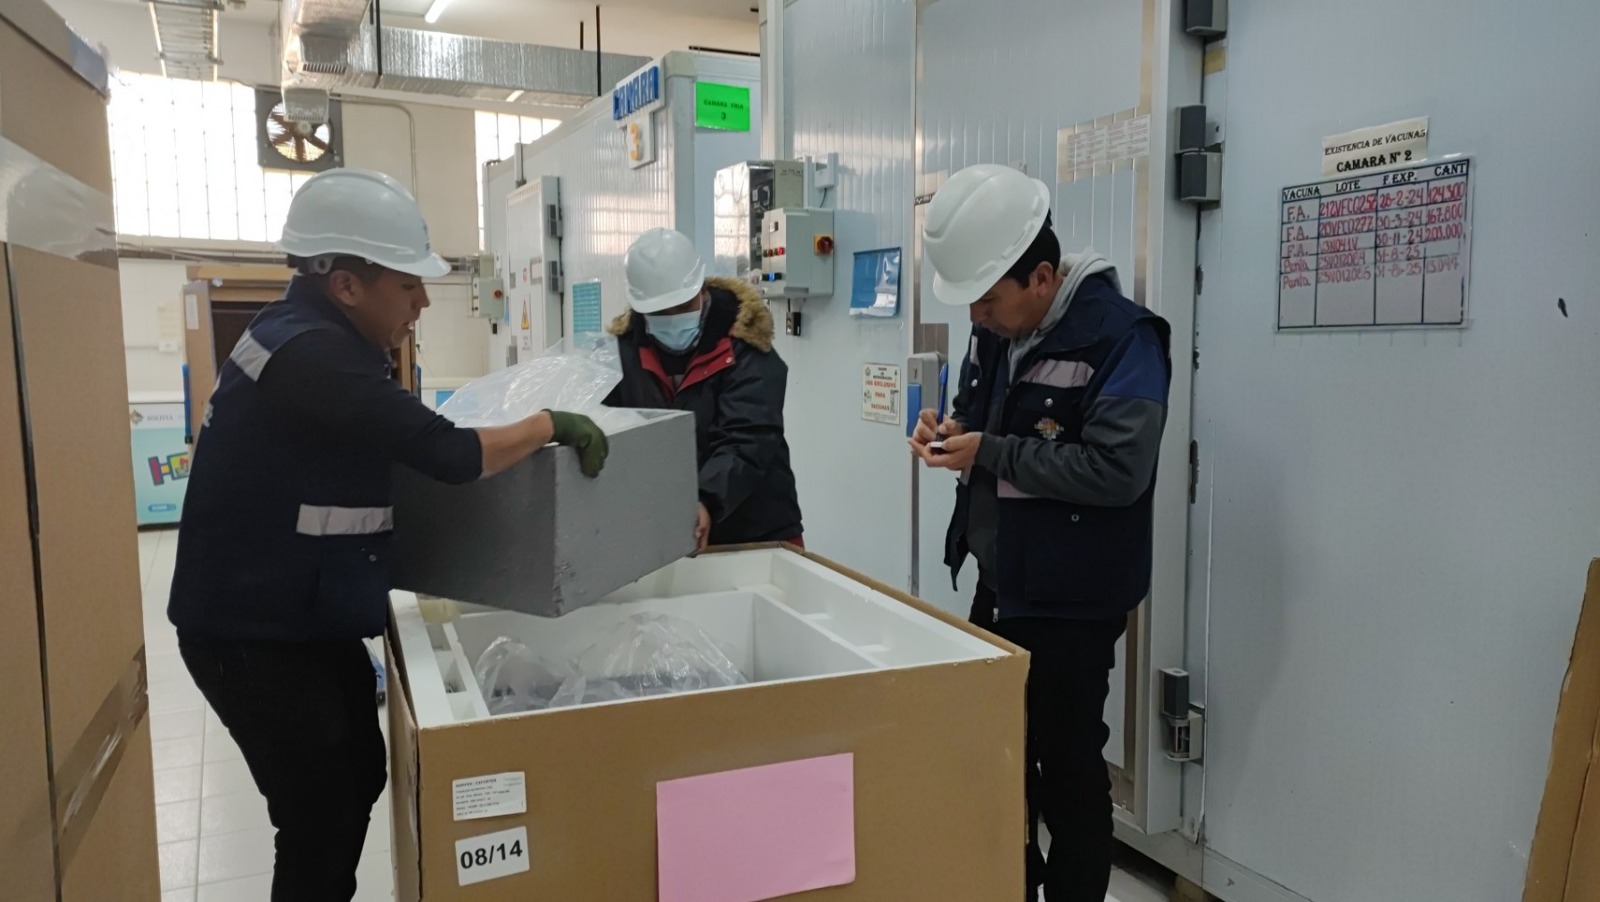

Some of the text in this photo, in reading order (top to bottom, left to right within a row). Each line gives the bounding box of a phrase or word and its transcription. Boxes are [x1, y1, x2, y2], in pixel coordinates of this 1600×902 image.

[613, 65, 659, 120] CAMARA
[703, 99, 744, 110] CAMARA FRIA
[720, 112, 727, 120] 3
[630, 122, 639, 161] 3
[1324, 129, 1426, 155] EXISTENCIA DE VACUNAS
[1336, 155, 1386, 173] CAMARA
[1404, 150, 1412, 161] 2
[1283, 186, 1321, 200] VACUNA
[1335, 180, 1361, 193] LOTE
[1434, 162, 1466, 177] CANT
[1287, 204, 1310, 221] F.A.
[1286, 225, 1310, 242] F.A.
[1286, 244, 1309, 257] F.A.
[460, 839, 523, 869] 08/14
